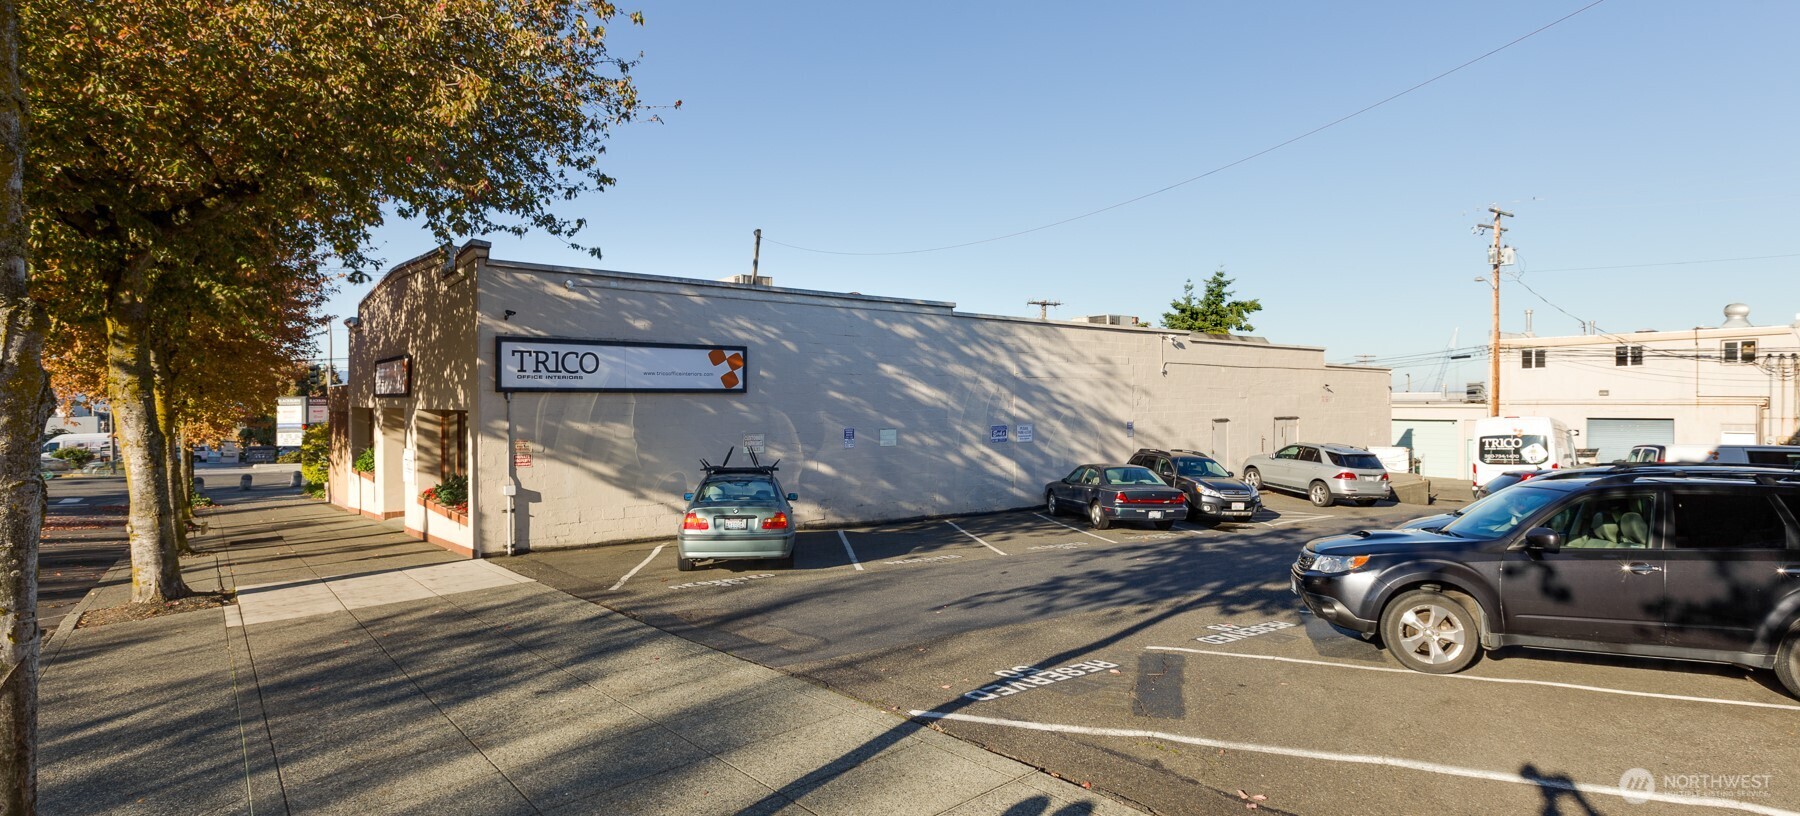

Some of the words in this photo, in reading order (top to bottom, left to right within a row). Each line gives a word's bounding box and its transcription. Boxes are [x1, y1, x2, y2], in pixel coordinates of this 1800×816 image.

[511, 350, 600, 374] TRICO
[1482, 438, 1522, 448] TRICO
[964, 659, 1119, 701] RESERVED
